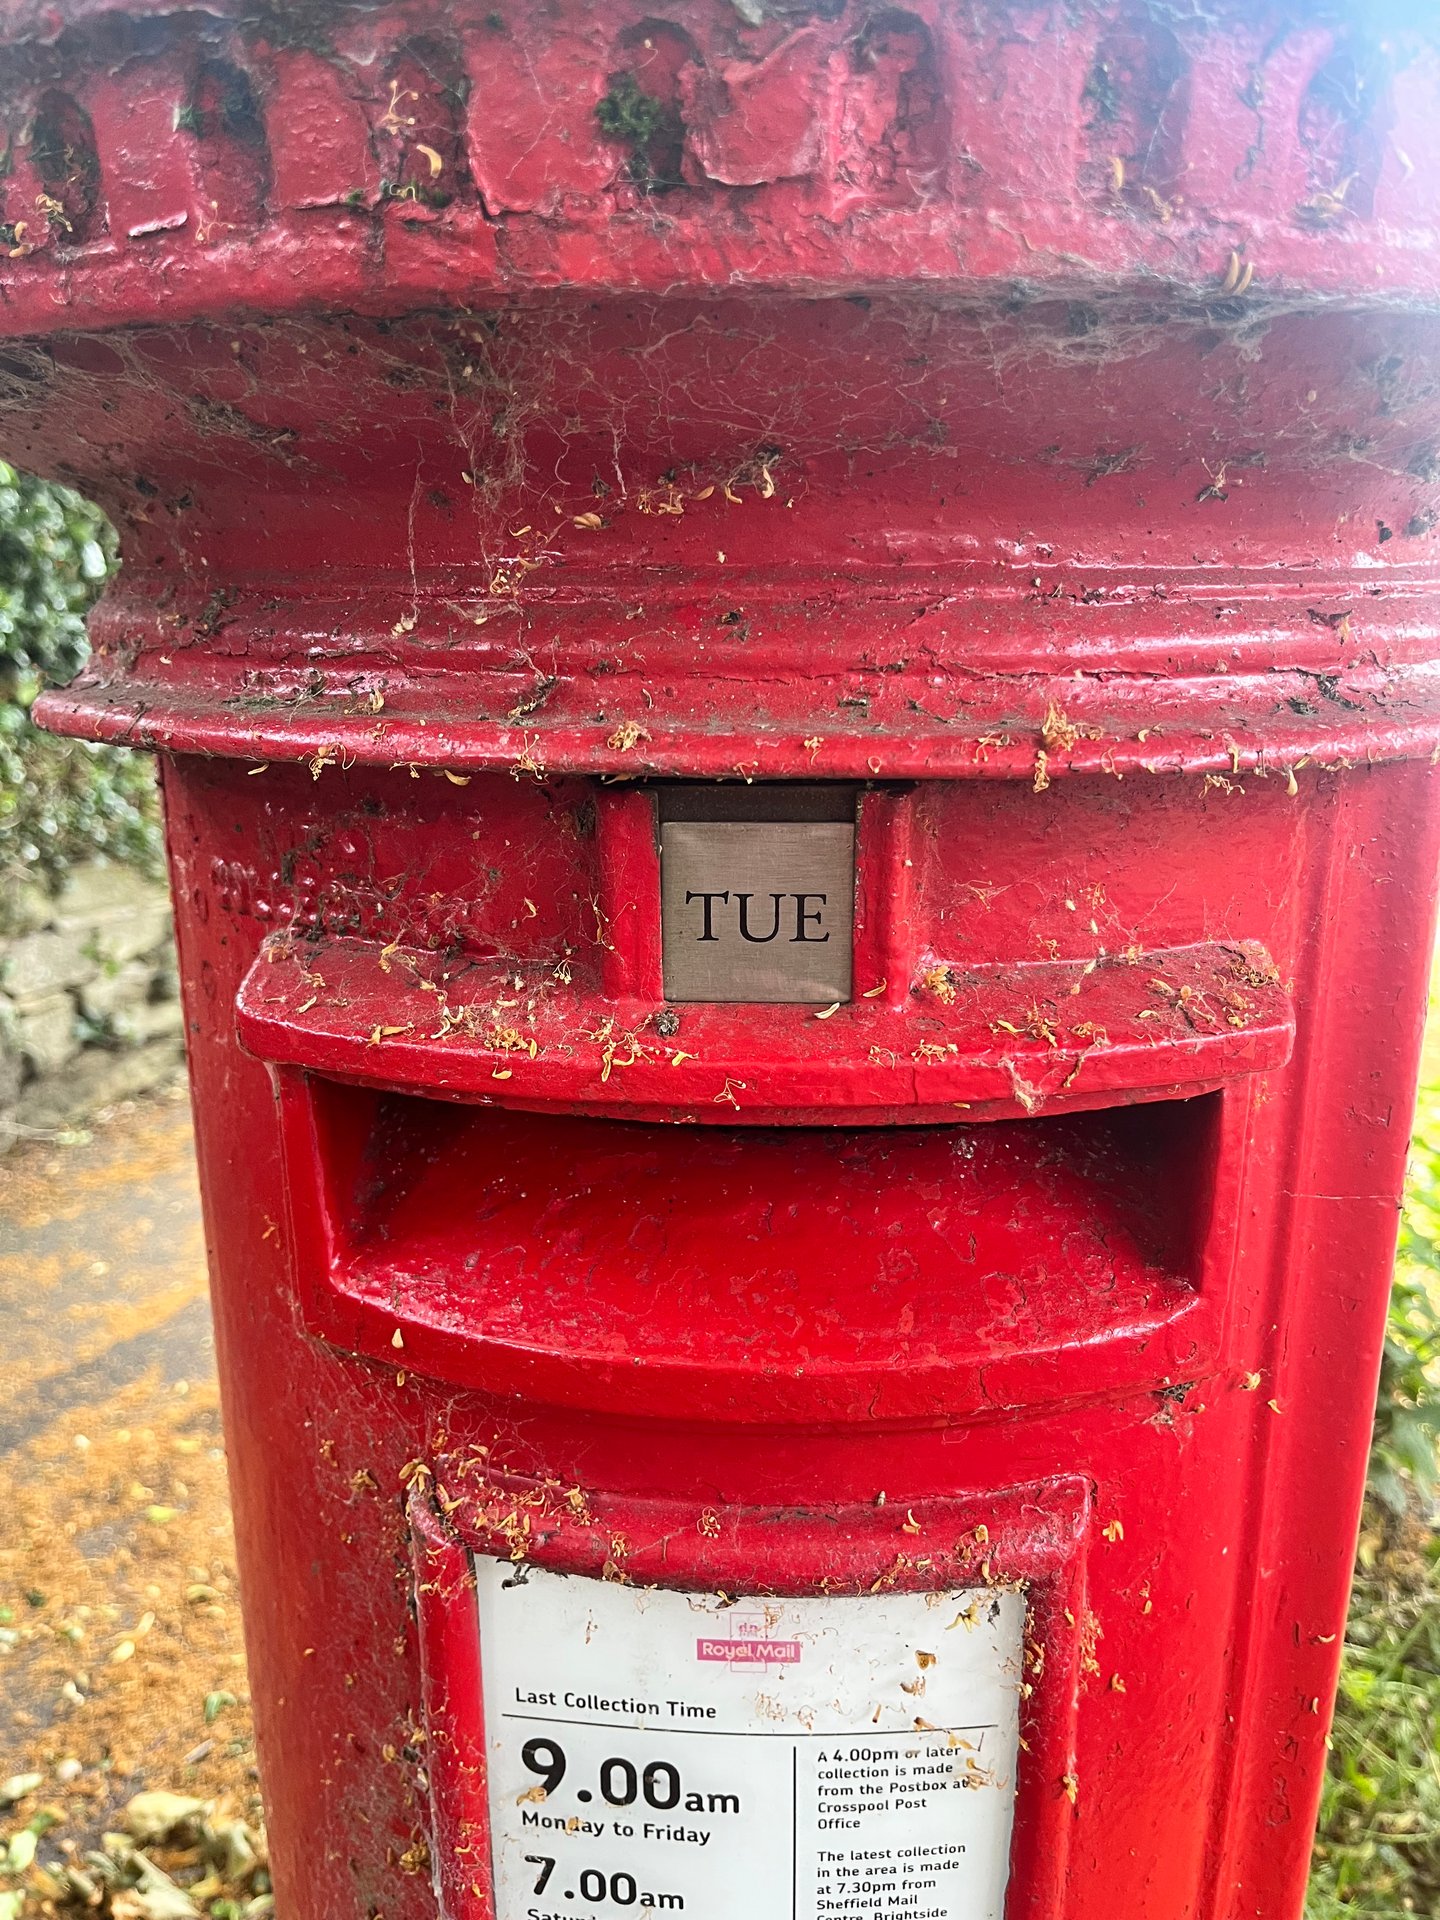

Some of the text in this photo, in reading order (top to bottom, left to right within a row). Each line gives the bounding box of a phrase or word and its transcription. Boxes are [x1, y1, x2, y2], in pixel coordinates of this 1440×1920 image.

[685, 890, 830, 943] TUE
[702, 1642, 795, 1659] Royal Mail
[515, 1687, 717, 1718] Last Collection Time
[817, 1746, 961, 1763] A 4.00pm or later
[521, 1738, 740, 1814] 9.00am
[818, 1762, 953, 1780] collection is made
[818, 1778, 968, 1796] from the Postbox at
[818, 1798, 928, 1814] Crosspool Post
[818, 1818, 861, 1830] Office
[613, 1822, 634, 1837] to
[643, 1823, 712, 1846] Friday
[817, 1844, 966, 1862] The latest collection
[817, 1860, 960, 1878] in the area is made
[524, 1855, 685, 1910] 7.00am
[816, 1879, 936, 1894] at 7.30pm from
[816, 1894, 918, 1910] Sheffield Mail
[874, 1908, 948, 1920] Brightside
